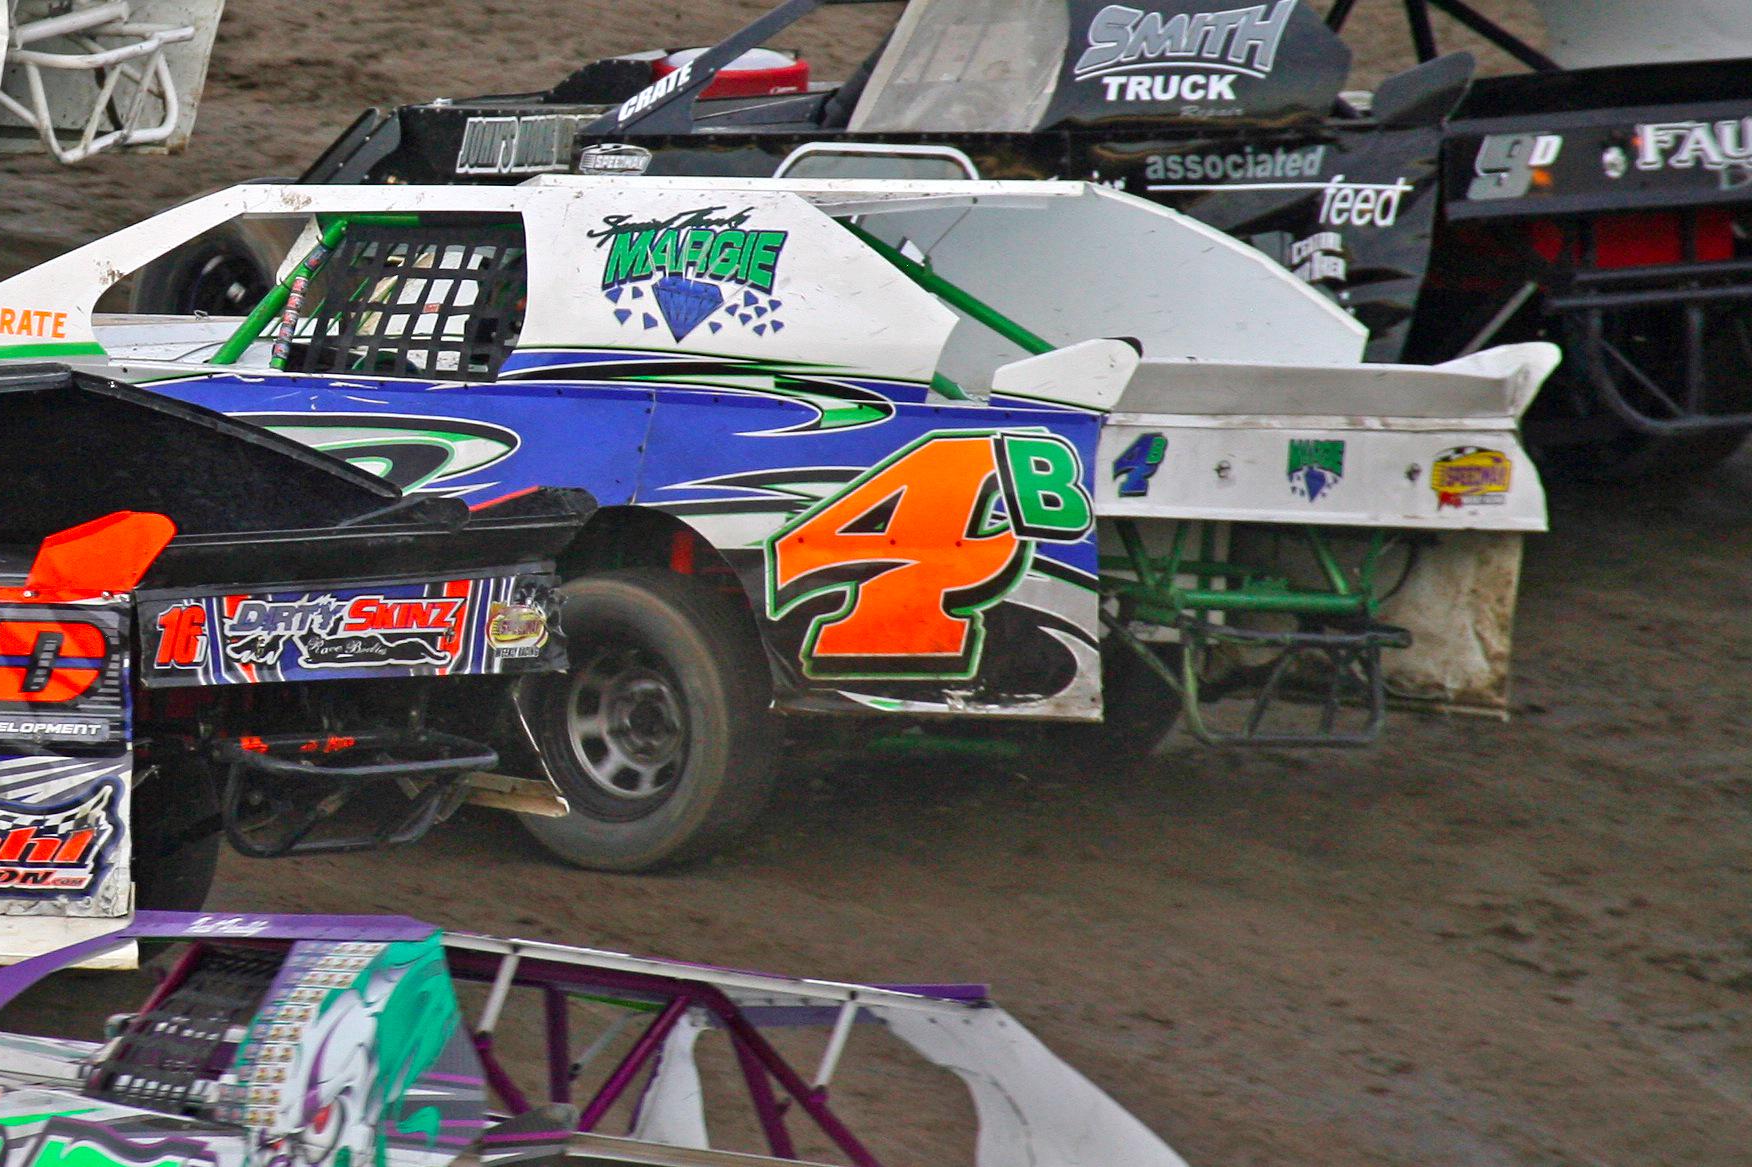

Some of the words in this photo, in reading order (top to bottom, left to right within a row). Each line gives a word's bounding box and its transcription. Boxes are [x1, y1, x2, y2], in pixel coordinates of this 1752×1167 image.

[1074, 0, 1300, 74] SMITH
[617, 59, 694, 122] CRATE
[1101, 74, 1239, 101] TRUCK
[1146, 145, 1326, 180] associated
[1318, 174, 1407, 227] feed
[601, 228, 789, 295] MARGIE
[765, 427, 1094, 679] 4B
[220, 603, 348, 633] DIRTY
[343, 598, 462, 632] SKINZ
